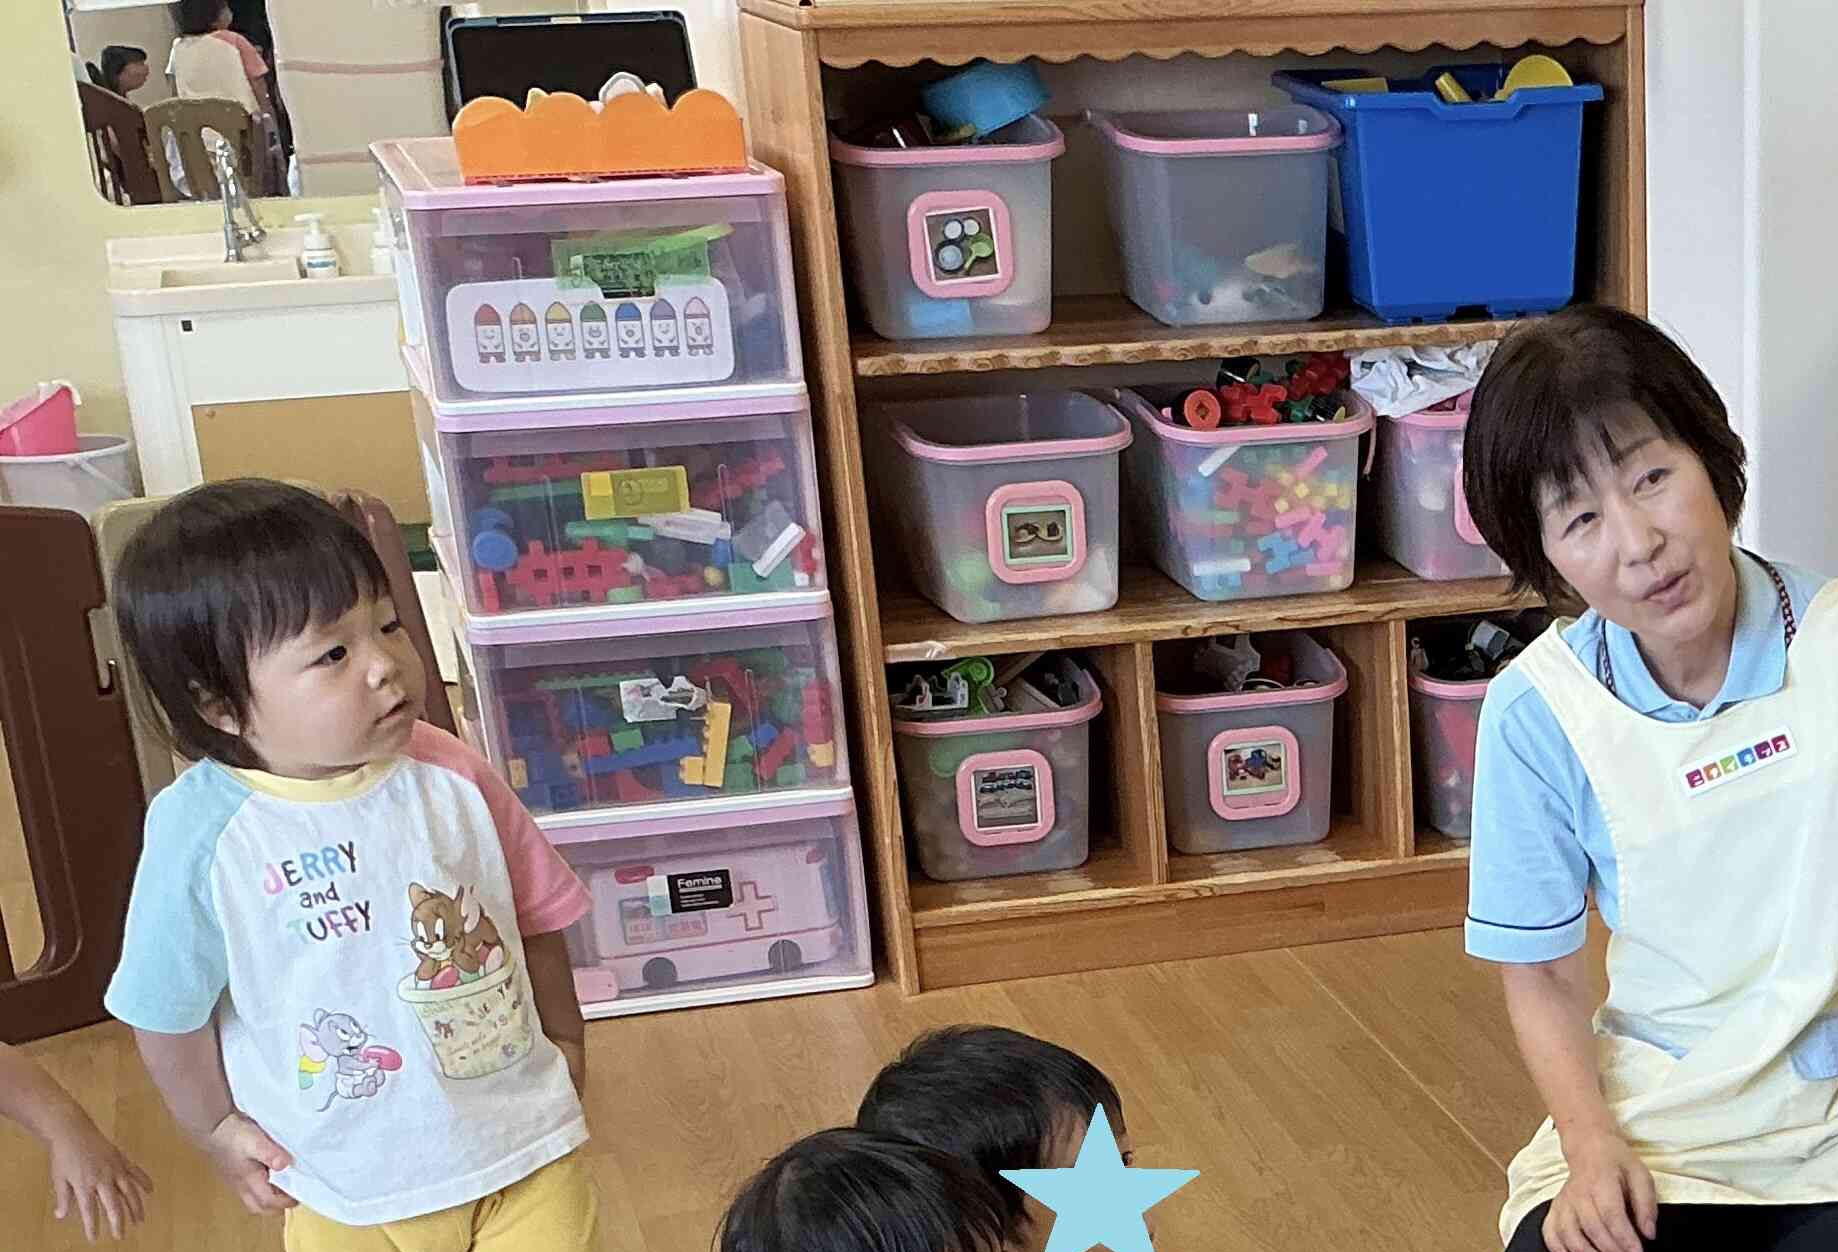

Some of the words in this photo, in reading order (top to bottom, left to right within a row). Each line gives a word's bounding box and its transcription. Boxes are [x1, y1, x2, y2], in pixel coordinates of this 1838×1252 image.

[263, 841, 356, 895] JERRY
[299, 881, 340, 909] and
[286, 900, 370, 944] TUFFY
